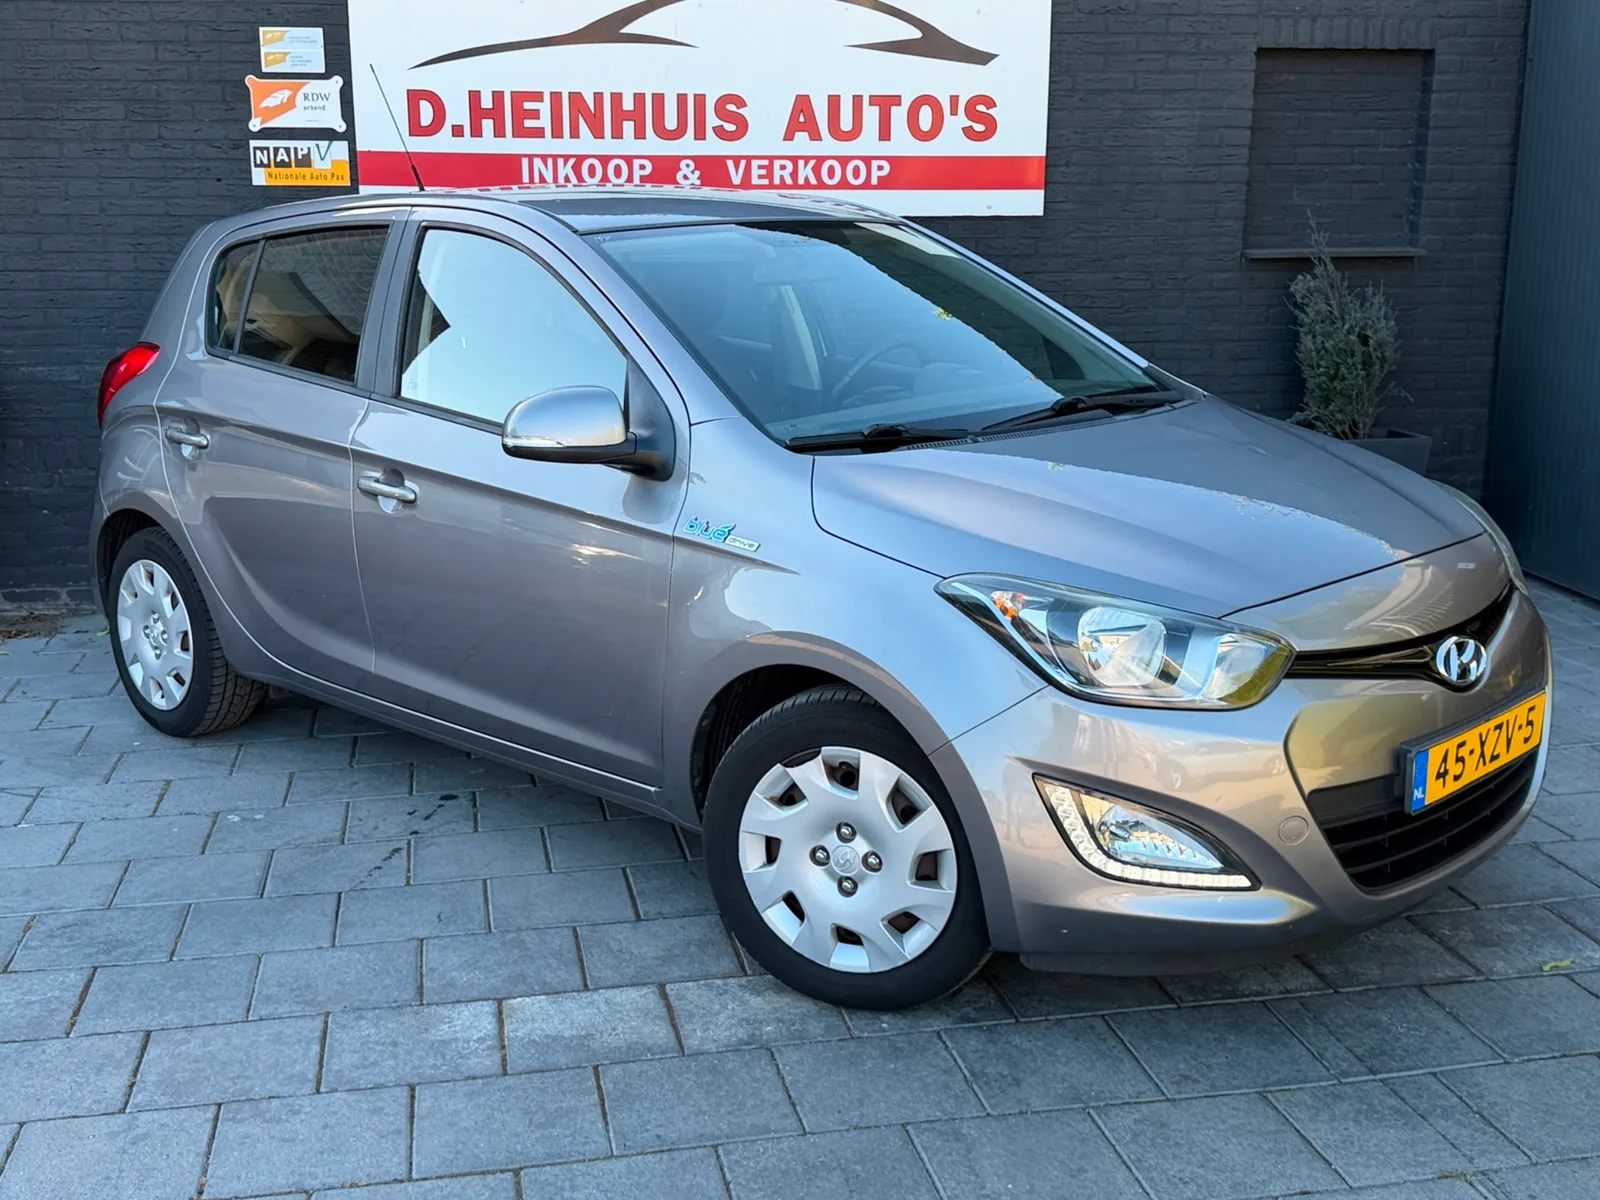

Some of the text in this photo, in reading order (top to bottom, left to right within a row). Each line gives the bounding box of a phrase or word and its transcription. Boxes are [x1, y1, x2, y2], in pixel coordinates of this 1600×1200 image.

[303, 92, 331, 102] RDW
[406, 88, 998, 142] D.HEINHUIS AUTO'S
[267, 171, 345, 181] Nationale Auto Pas
[521, 157, 891, 186] INKOOP & VERKOOP
[683, 515, 730, 543] blue
[728, 536, 756, 549] drive
[1434, 704, 1537, 789] 45-XZV-5
[1413, 787, 1425, 801] NL
